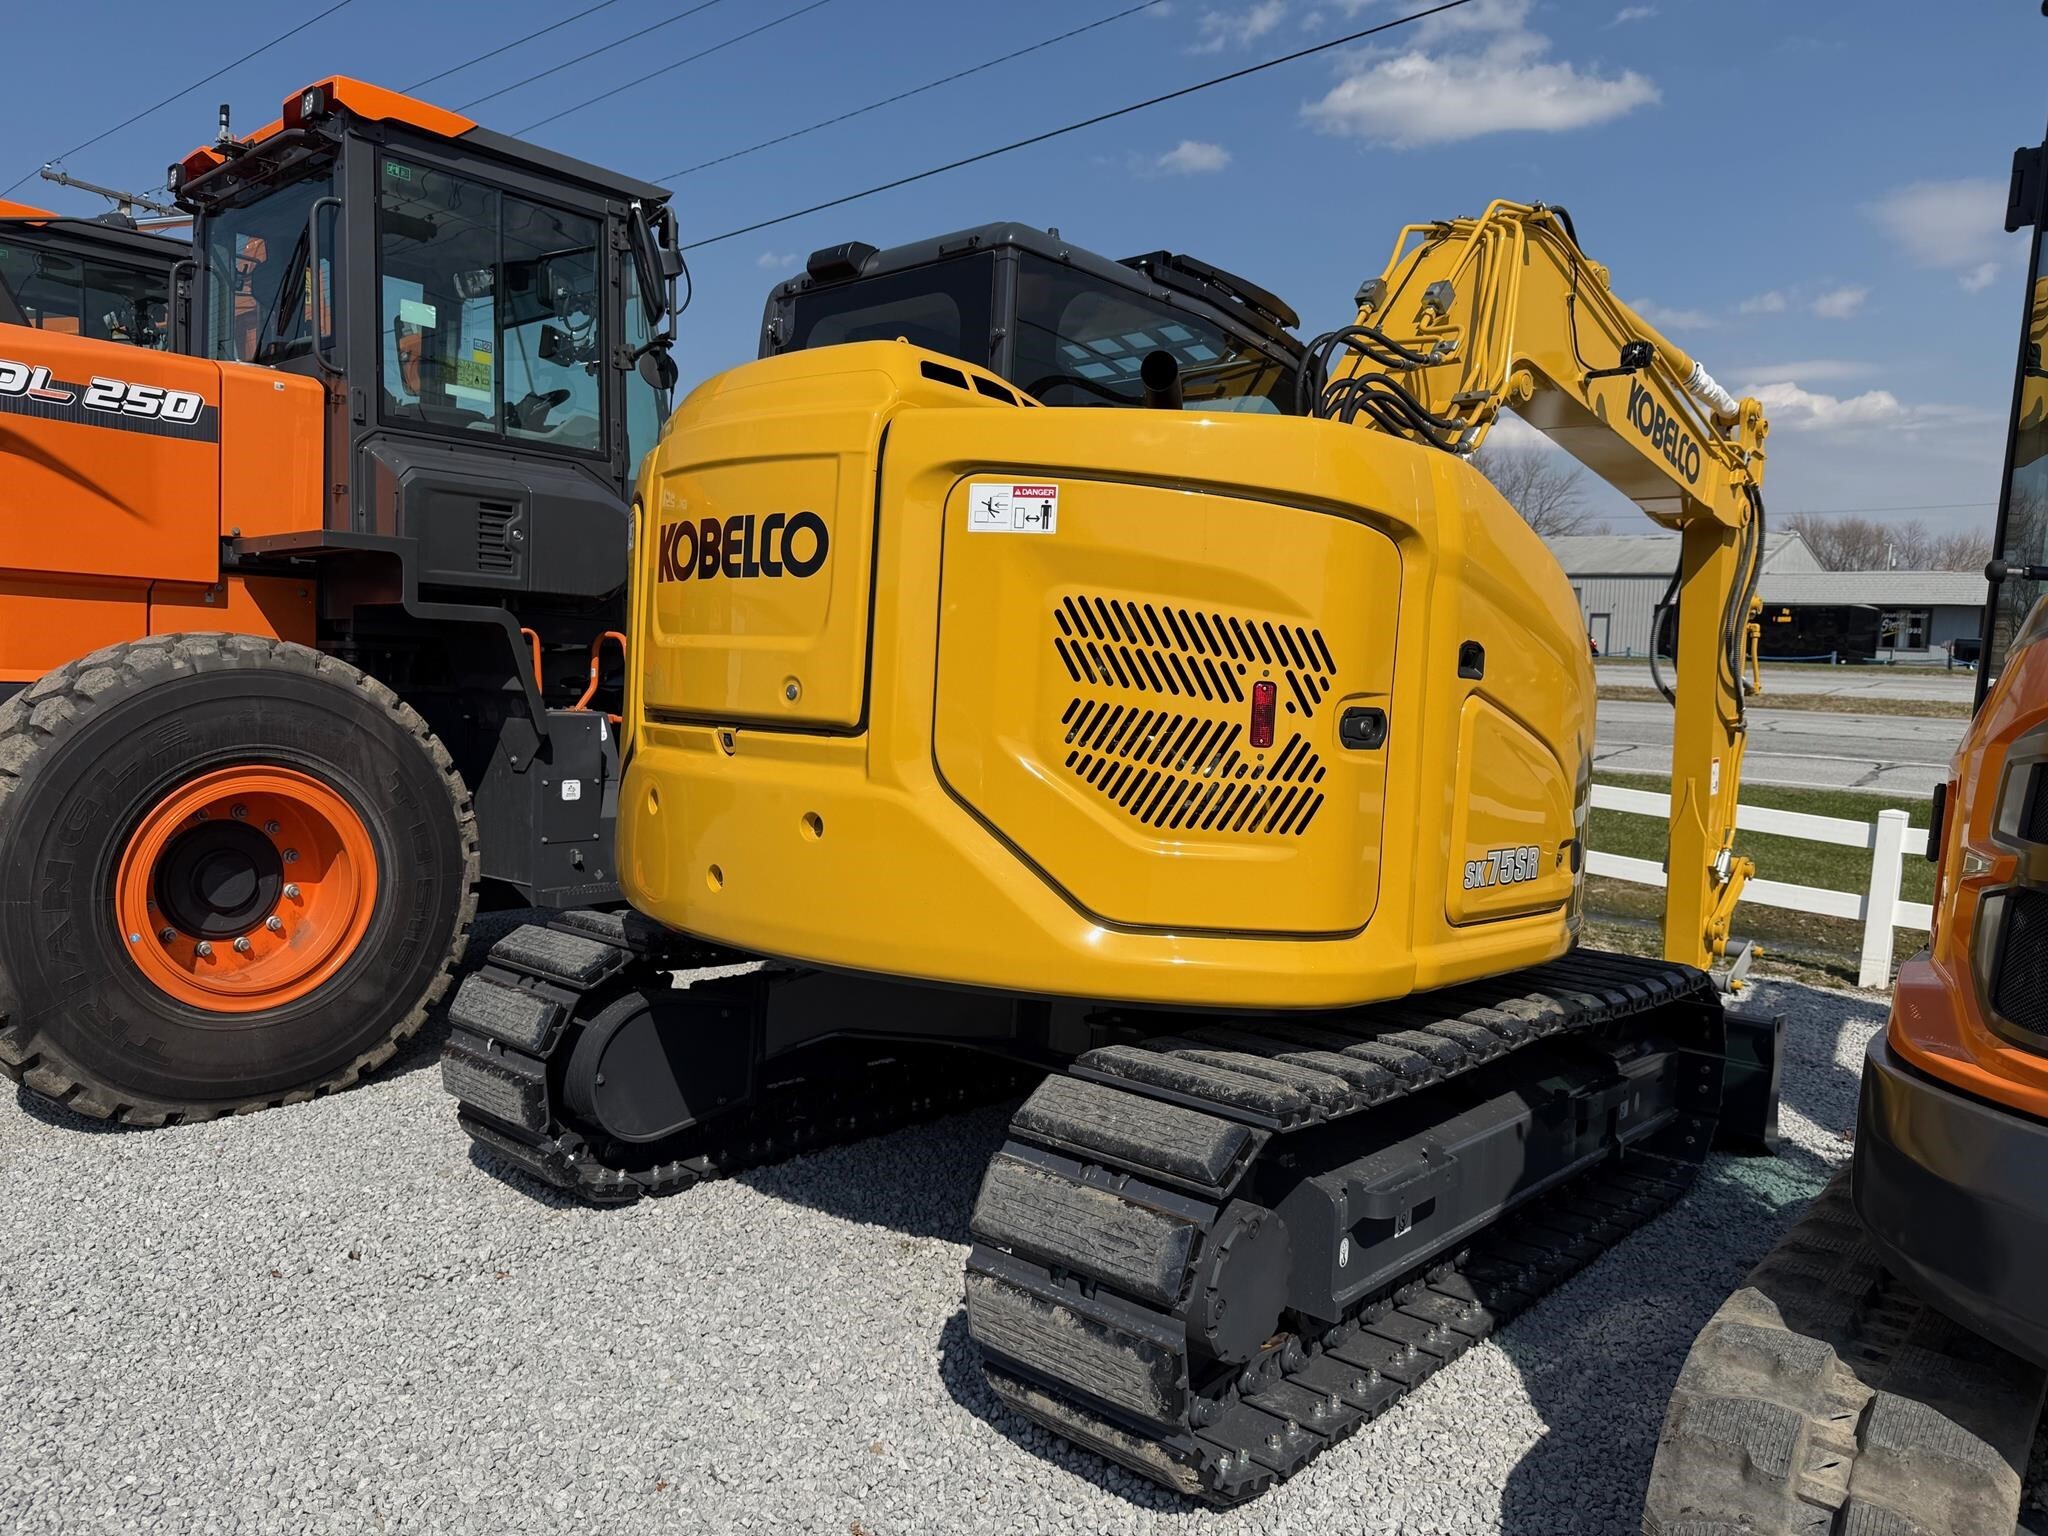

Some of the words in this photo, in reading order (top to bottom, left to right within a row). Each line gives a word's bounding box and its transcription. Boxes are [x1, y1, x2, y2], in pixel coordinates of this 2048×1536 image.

[82, 376, 206, 425] 250
[1626, 376, 1700, 484] KOBELCO
[1022, 488, 1055, 496] DANGER
[658, 511, 829, 583] KOBELCO
[41, 717, 193, 1066] TRIANGLE
[1463, 845, 1540, 890] SK75SR
